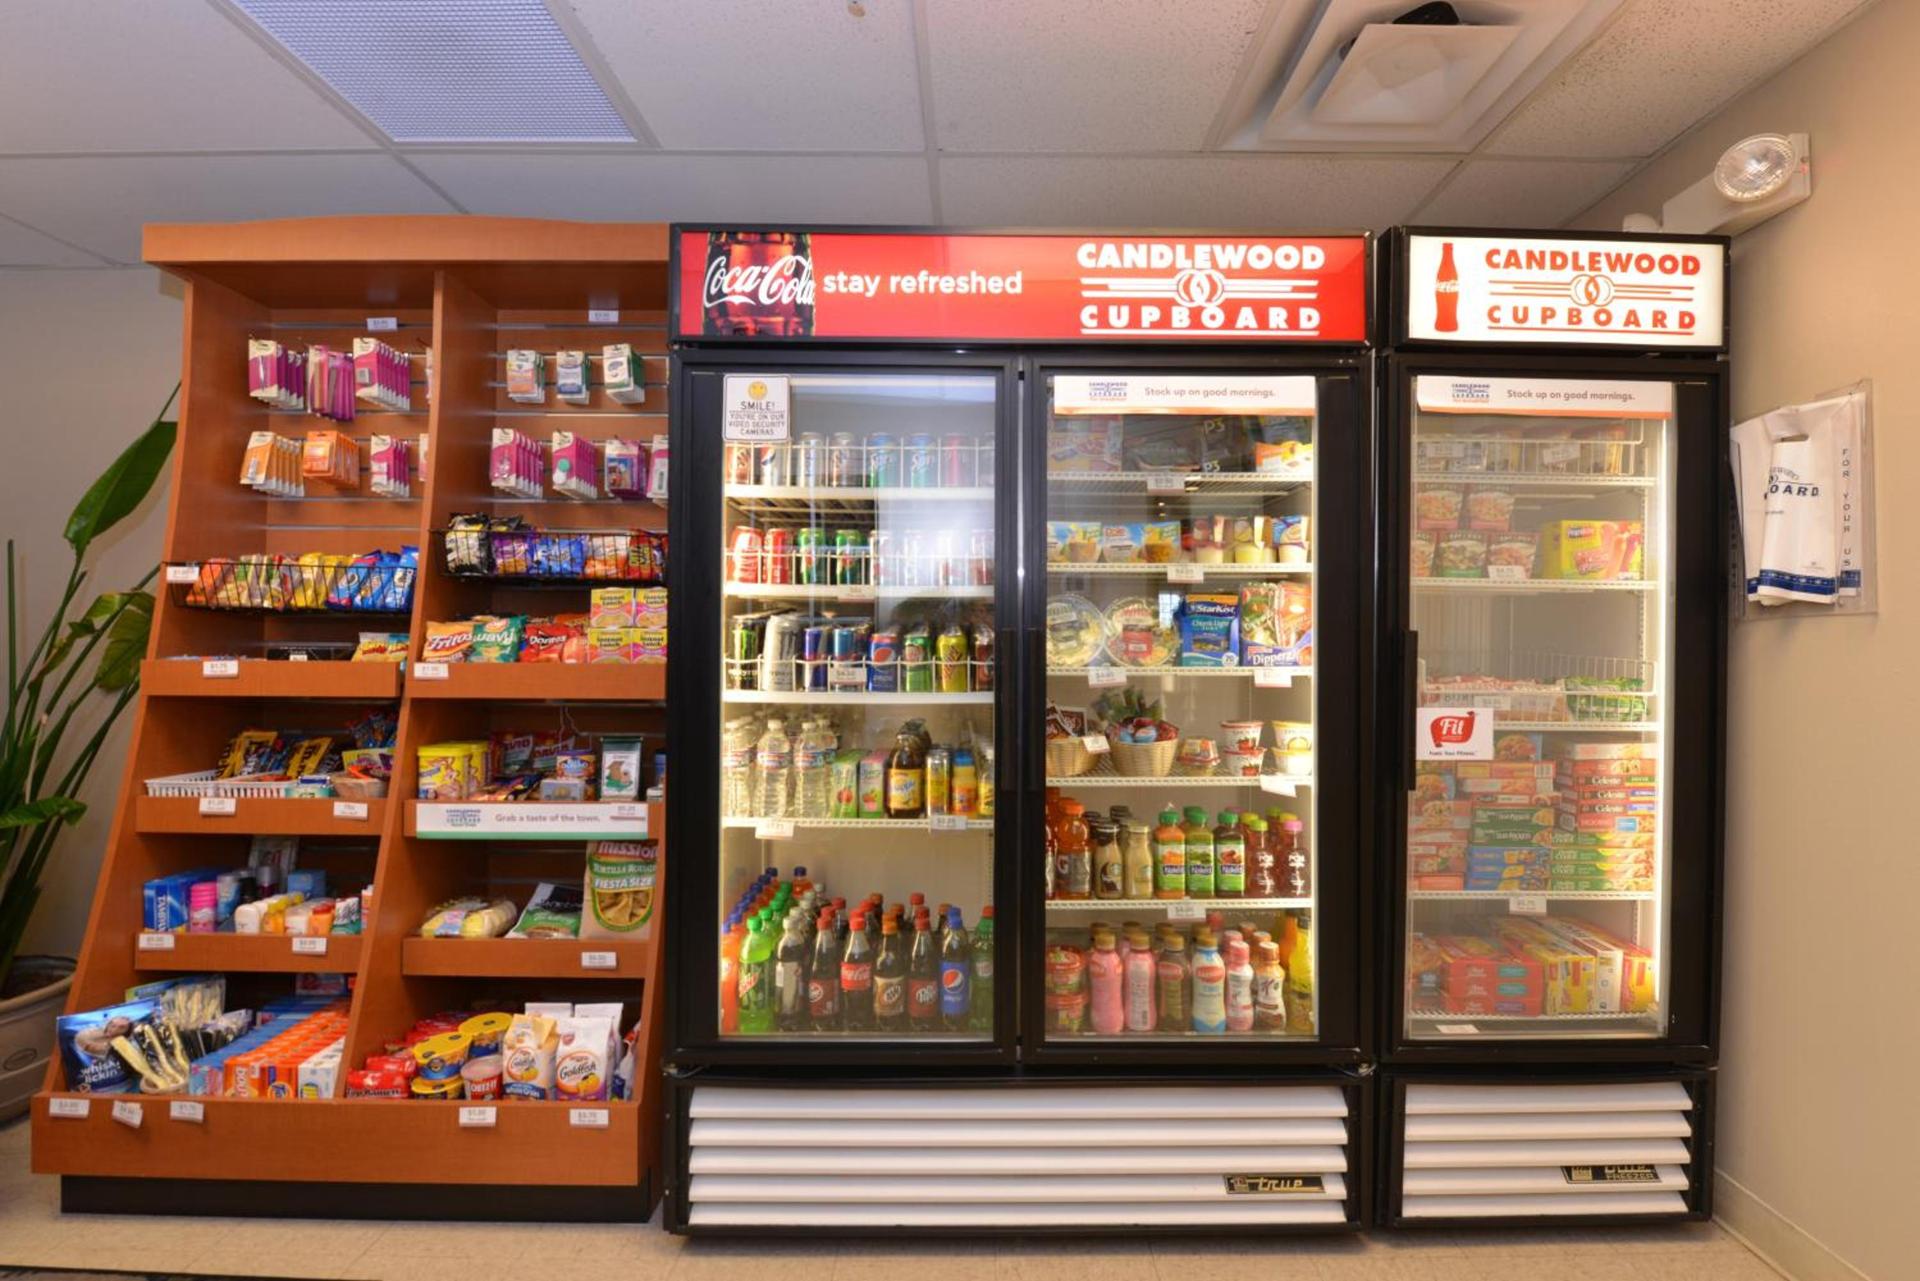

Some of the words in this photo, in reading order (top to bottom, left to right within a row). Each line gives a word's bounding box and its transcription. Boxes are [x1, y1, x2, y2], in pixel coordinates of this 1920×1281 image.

[1076, 242, 1326, 270] CANDLEWOOD
[1484, 247, 1701, 276] CANDLEWOOD
[703, 255, 816, 308] Coca-Cola
[822, 271, 880, 297] stay
[889, 269, 1023, 295] refreshed
[1079, 304, 1321, 330] CUPBOARD
[1487, 304, 1696, 330] CUPBOARD
[1145, 387, 1171, 397] Stock
[1174, 388, 1185, 399] up
[1188, 389, 1200, 397] on
[1203, 387, 1227, 399] good
[1230, 387, 1275, 399] mornings.
[1507, 388, 1533, 399] Stock
[1535, 391, 1547, 401] up
[1550, 391, 1562, 399] on
[1564, 390, 1588, 402] good
[1590, 390, 1636, 402] mornings.
[740, 400, 776, 411] SMILE!
[1769, 484, 1820, 497] OARD
[1196, 604, 1236, 615] StarKist
[431, 631, 473, 650] Fritos
[495, 813, 516, 823] Grab
[526, 814, 548, 823] taste
[550, 813, 559, 823] of
[560, 813, 575, 823] the
[577, 814, 601, 823] town.
[559, 1061, 597, 1080] Goldfish
[1259, 1177, 1303, 1191] true
